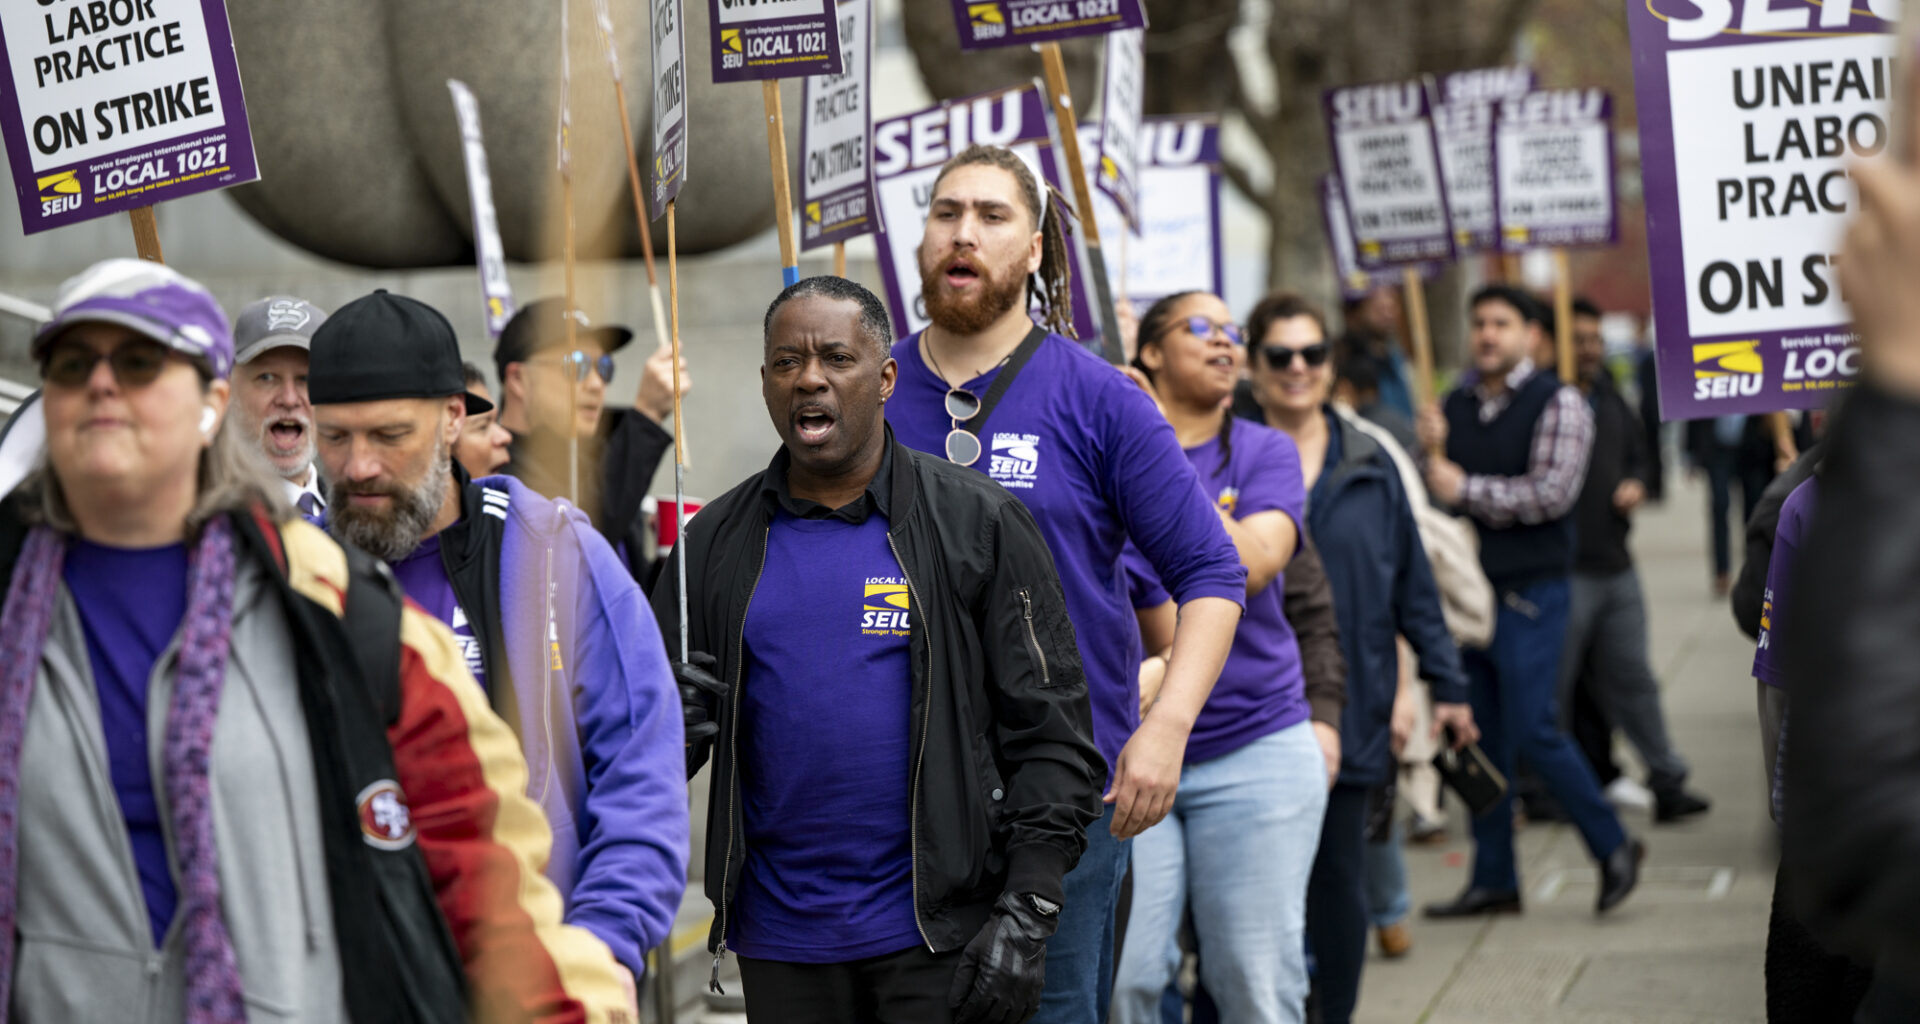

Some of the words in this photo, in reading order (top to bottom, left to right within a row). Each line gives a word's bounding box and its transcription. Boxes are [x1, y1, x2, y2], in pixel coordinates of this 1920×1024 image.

[45, 0, 156, 44] LABOR
[1011, 4, 1073, 27] LOCAL
[1076, 0, 1119, 18] 1021
[34, 21, 184, 88] PRACTICE
[722, 53, 743, 69] SEIU
[747, 35, 793, 57] LOCAL
[796, 32, 826, 53] 1021
[1732, 57, 1886, 110] UNFAI
[33, 108, 88, 155] ON
[94, 76, 213, 140] STRIKE
[874, 90, 1023, 177] SEIU
[89, 161, 114, 173] Service
[115, 151, 153, 166] Employees
[154, 139, 202, 157] International
[203, 133, 227, 144] Union
[1077, 120, 1205, 165] SIU
[1744, 112, 1888, 164] LABO
[94, 159, 170, 195] LOCAL
[176, 143, 227, 174] 1021
[808, 149, 826, 185] ON
[828, 136, 862, 178] STRIKE
[41, 193, 82, 218] SEIU
[1717, 169, 1847, 221] PRAC
[1699, 257, 1784, 315] ON
[1781, 336, 1822, 349] Service
[1783, 347, 1862, 379] LOC
[1694, 373, 1763, 400] SEIU
[993, 432, 1020, 441] LOCAL
[989, 460, 1037, 475] SEIU
[865, 576, 897, 585] LOCAL
[862, 628, 890, 637] Stronger
